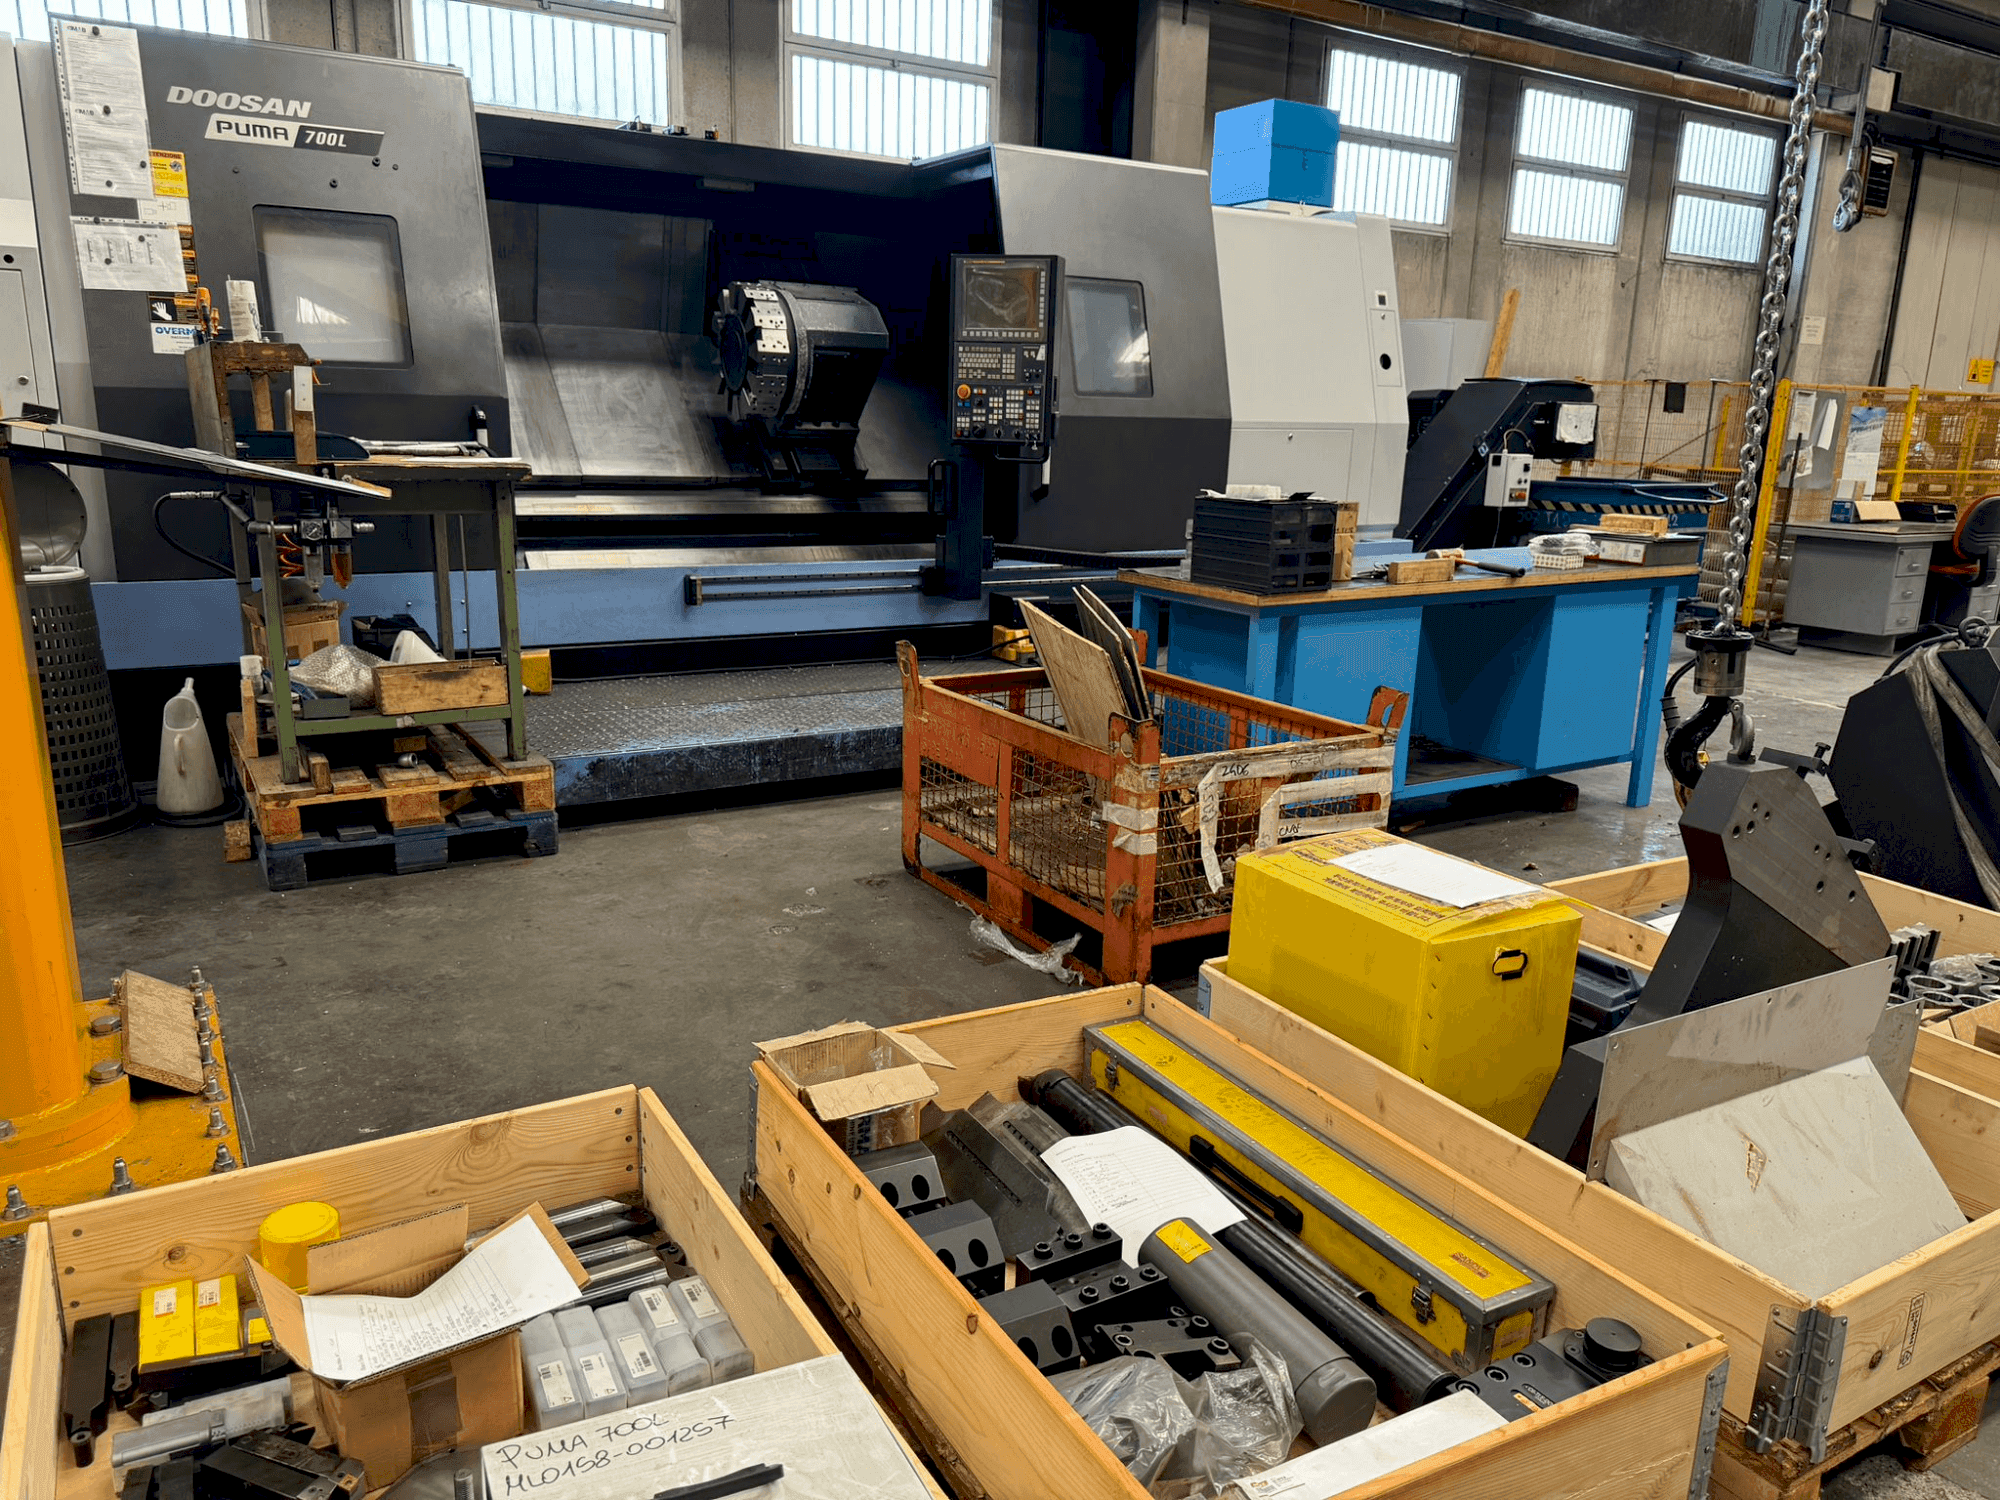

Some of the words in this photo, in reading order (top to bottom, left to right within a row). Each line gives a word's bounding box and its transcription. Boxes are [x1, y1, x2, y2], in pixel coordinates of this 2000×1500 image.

[166, 86, 312, 119] DOOSAN
[215, 119, 290, 141] PUMA
[304, 130, 347, 148] 700L
[155, 326, 196, 336] OVERM
[496, 1434, 588, 1470] PUMA
[595, 1413, 669, 1443] 700L
